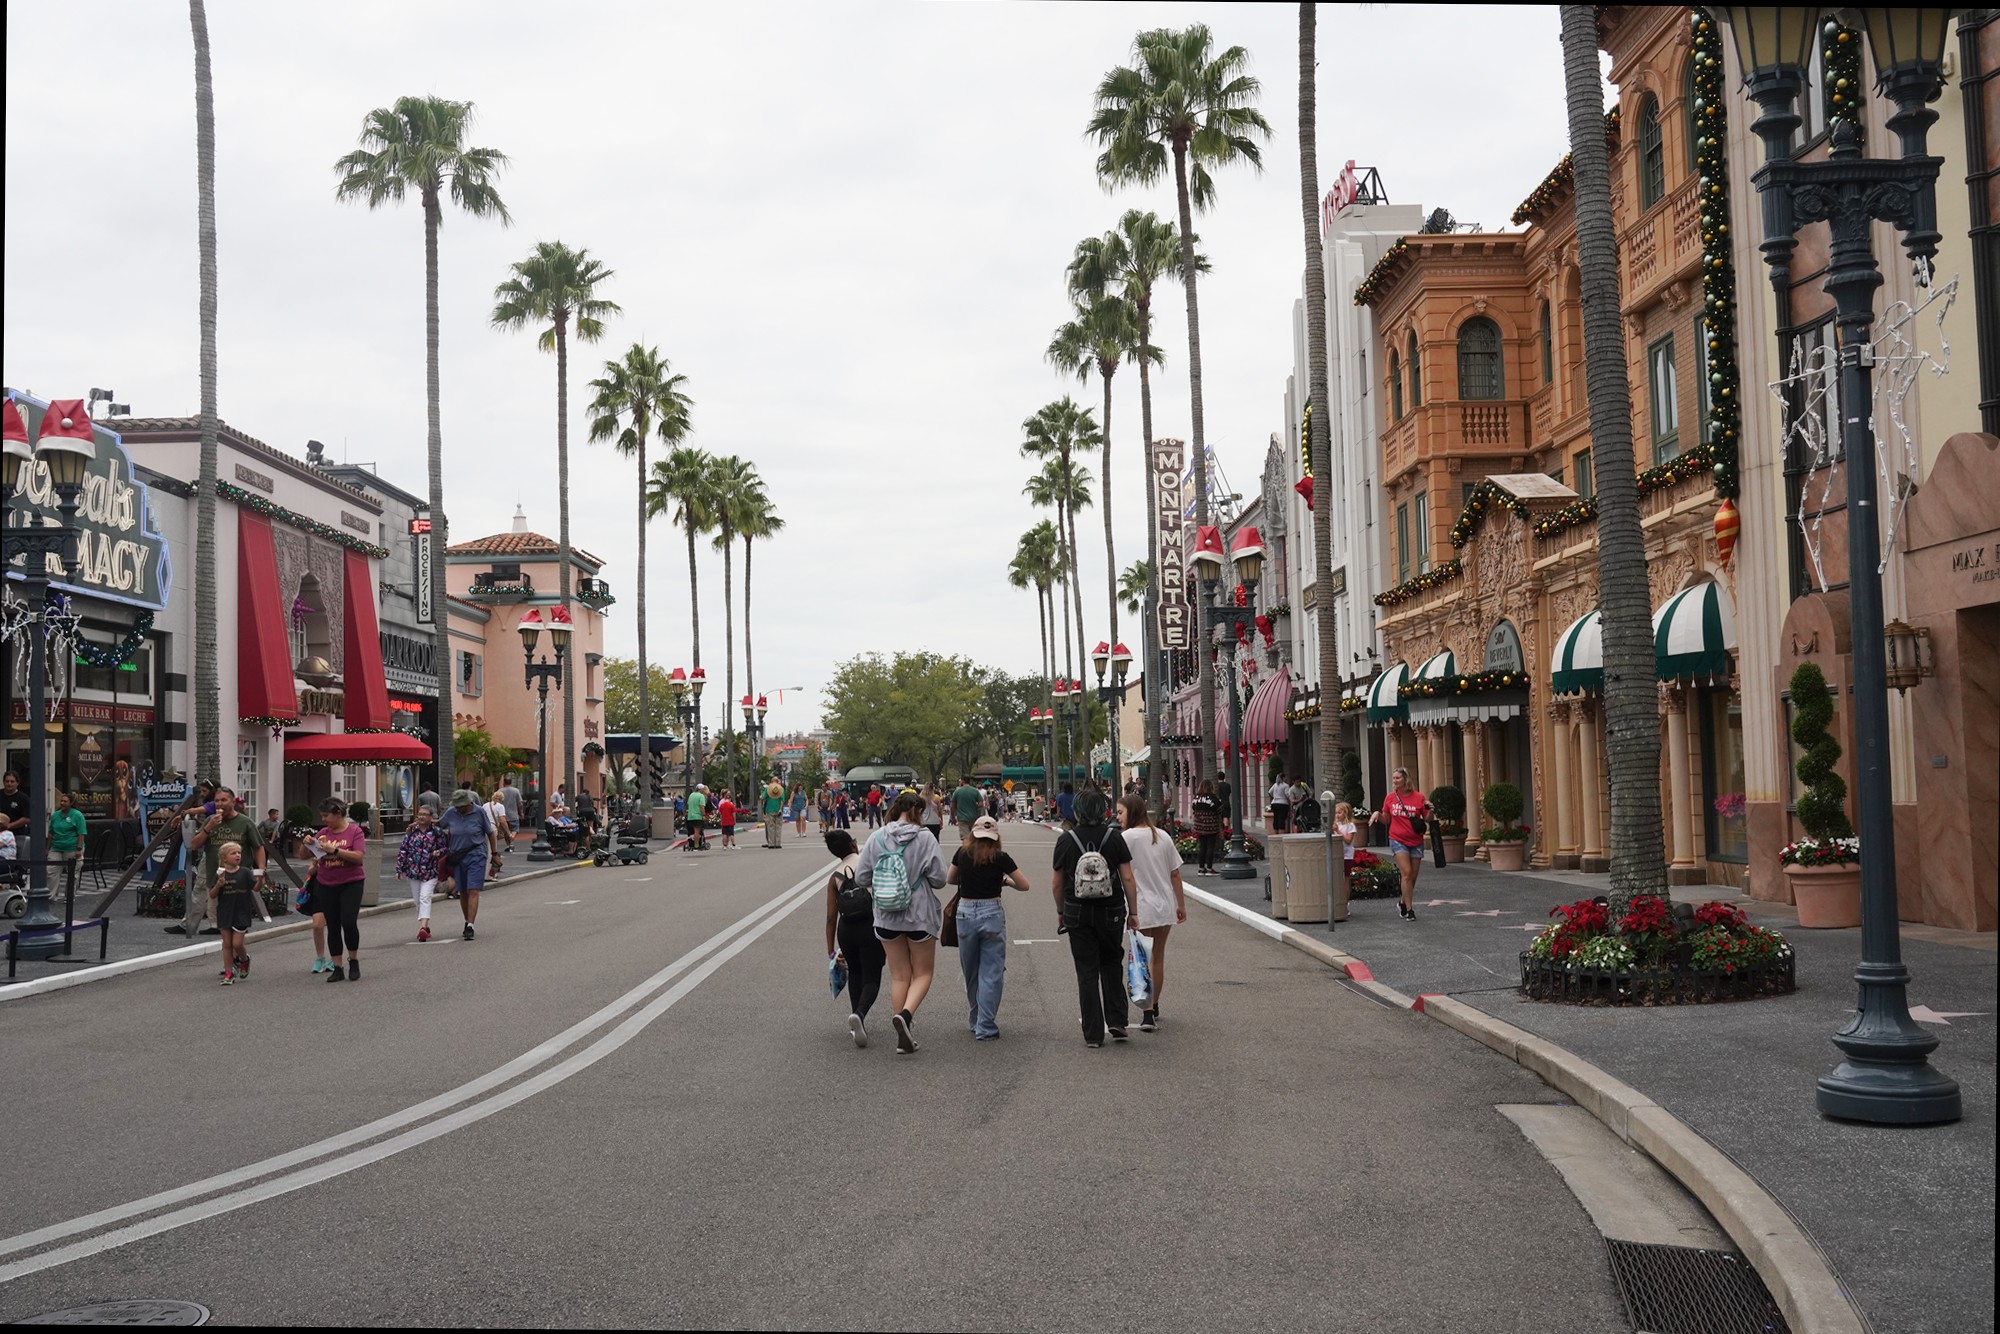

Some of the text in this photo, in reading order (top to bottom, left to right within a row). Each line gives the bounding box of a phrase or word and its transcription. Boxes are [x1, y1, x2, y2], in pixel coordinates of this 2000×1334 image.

[1158, 452, 1184, 644] MONTMARTRE
[1952, 547, 1985, 572] MAX
[1489, 645, 1513, 663] BEVERLY
[74, 706, 111, 719] MILK BAR
[123, 710, 147, 722] LECHE
[79, 753, 92, 761] MILK
